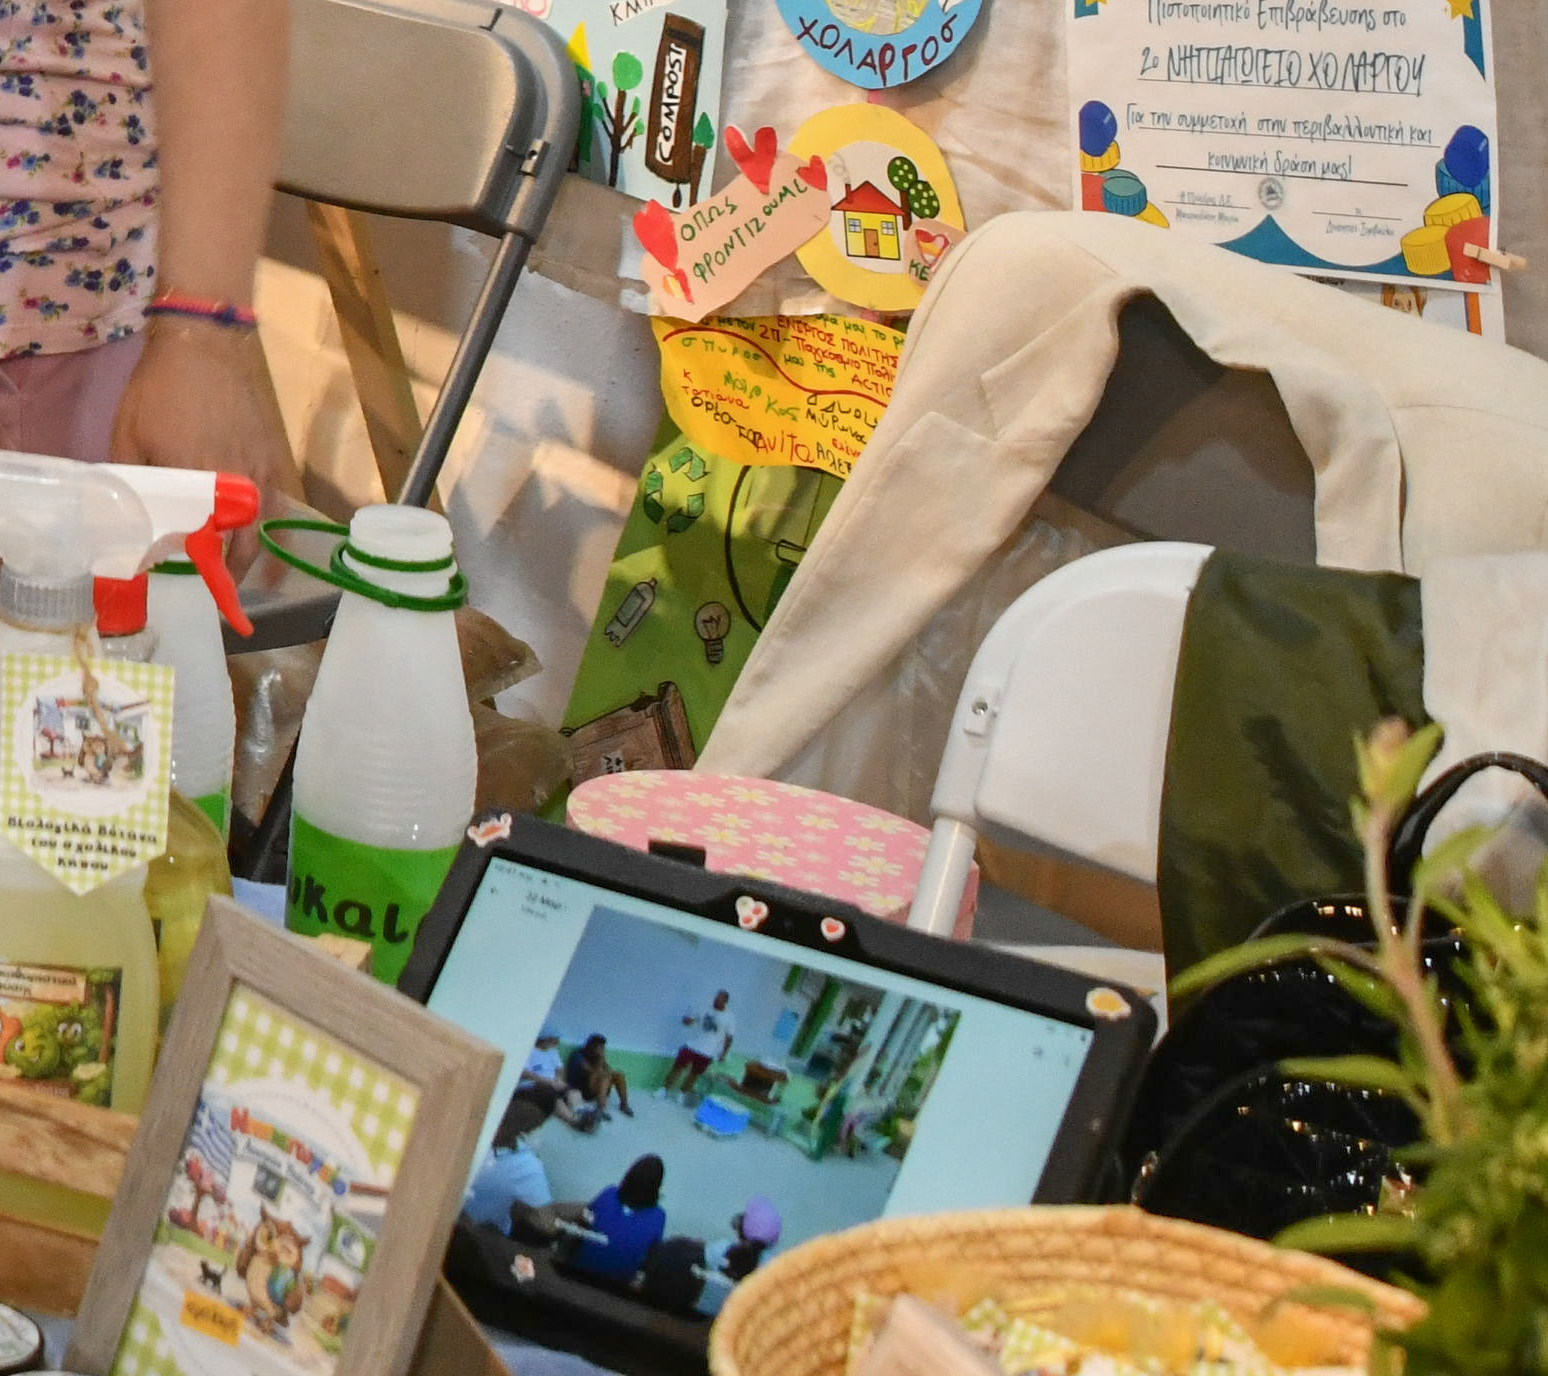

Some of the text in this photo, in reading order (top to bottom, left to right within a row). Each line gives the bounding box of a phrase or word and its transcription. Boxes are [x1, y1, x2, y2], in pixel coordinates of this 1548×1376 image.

[1383, 9, 1406, 27] στο
[1167, 46, 1302, 86] ΝΗΠΙΑΓΩΓΕΙΟ
[1308, 50, 1425, 97] ΧΟΛΑΡΓΟΥ
[657, 43, 686, 164] COMPOST
[1126, 103, 1431, 144] Για την συμμετοχή στην περιβαλλοντική και
[1207, 150, 1268, 170] κοινωνική
[1274, 152, 1318, 177] δράση
